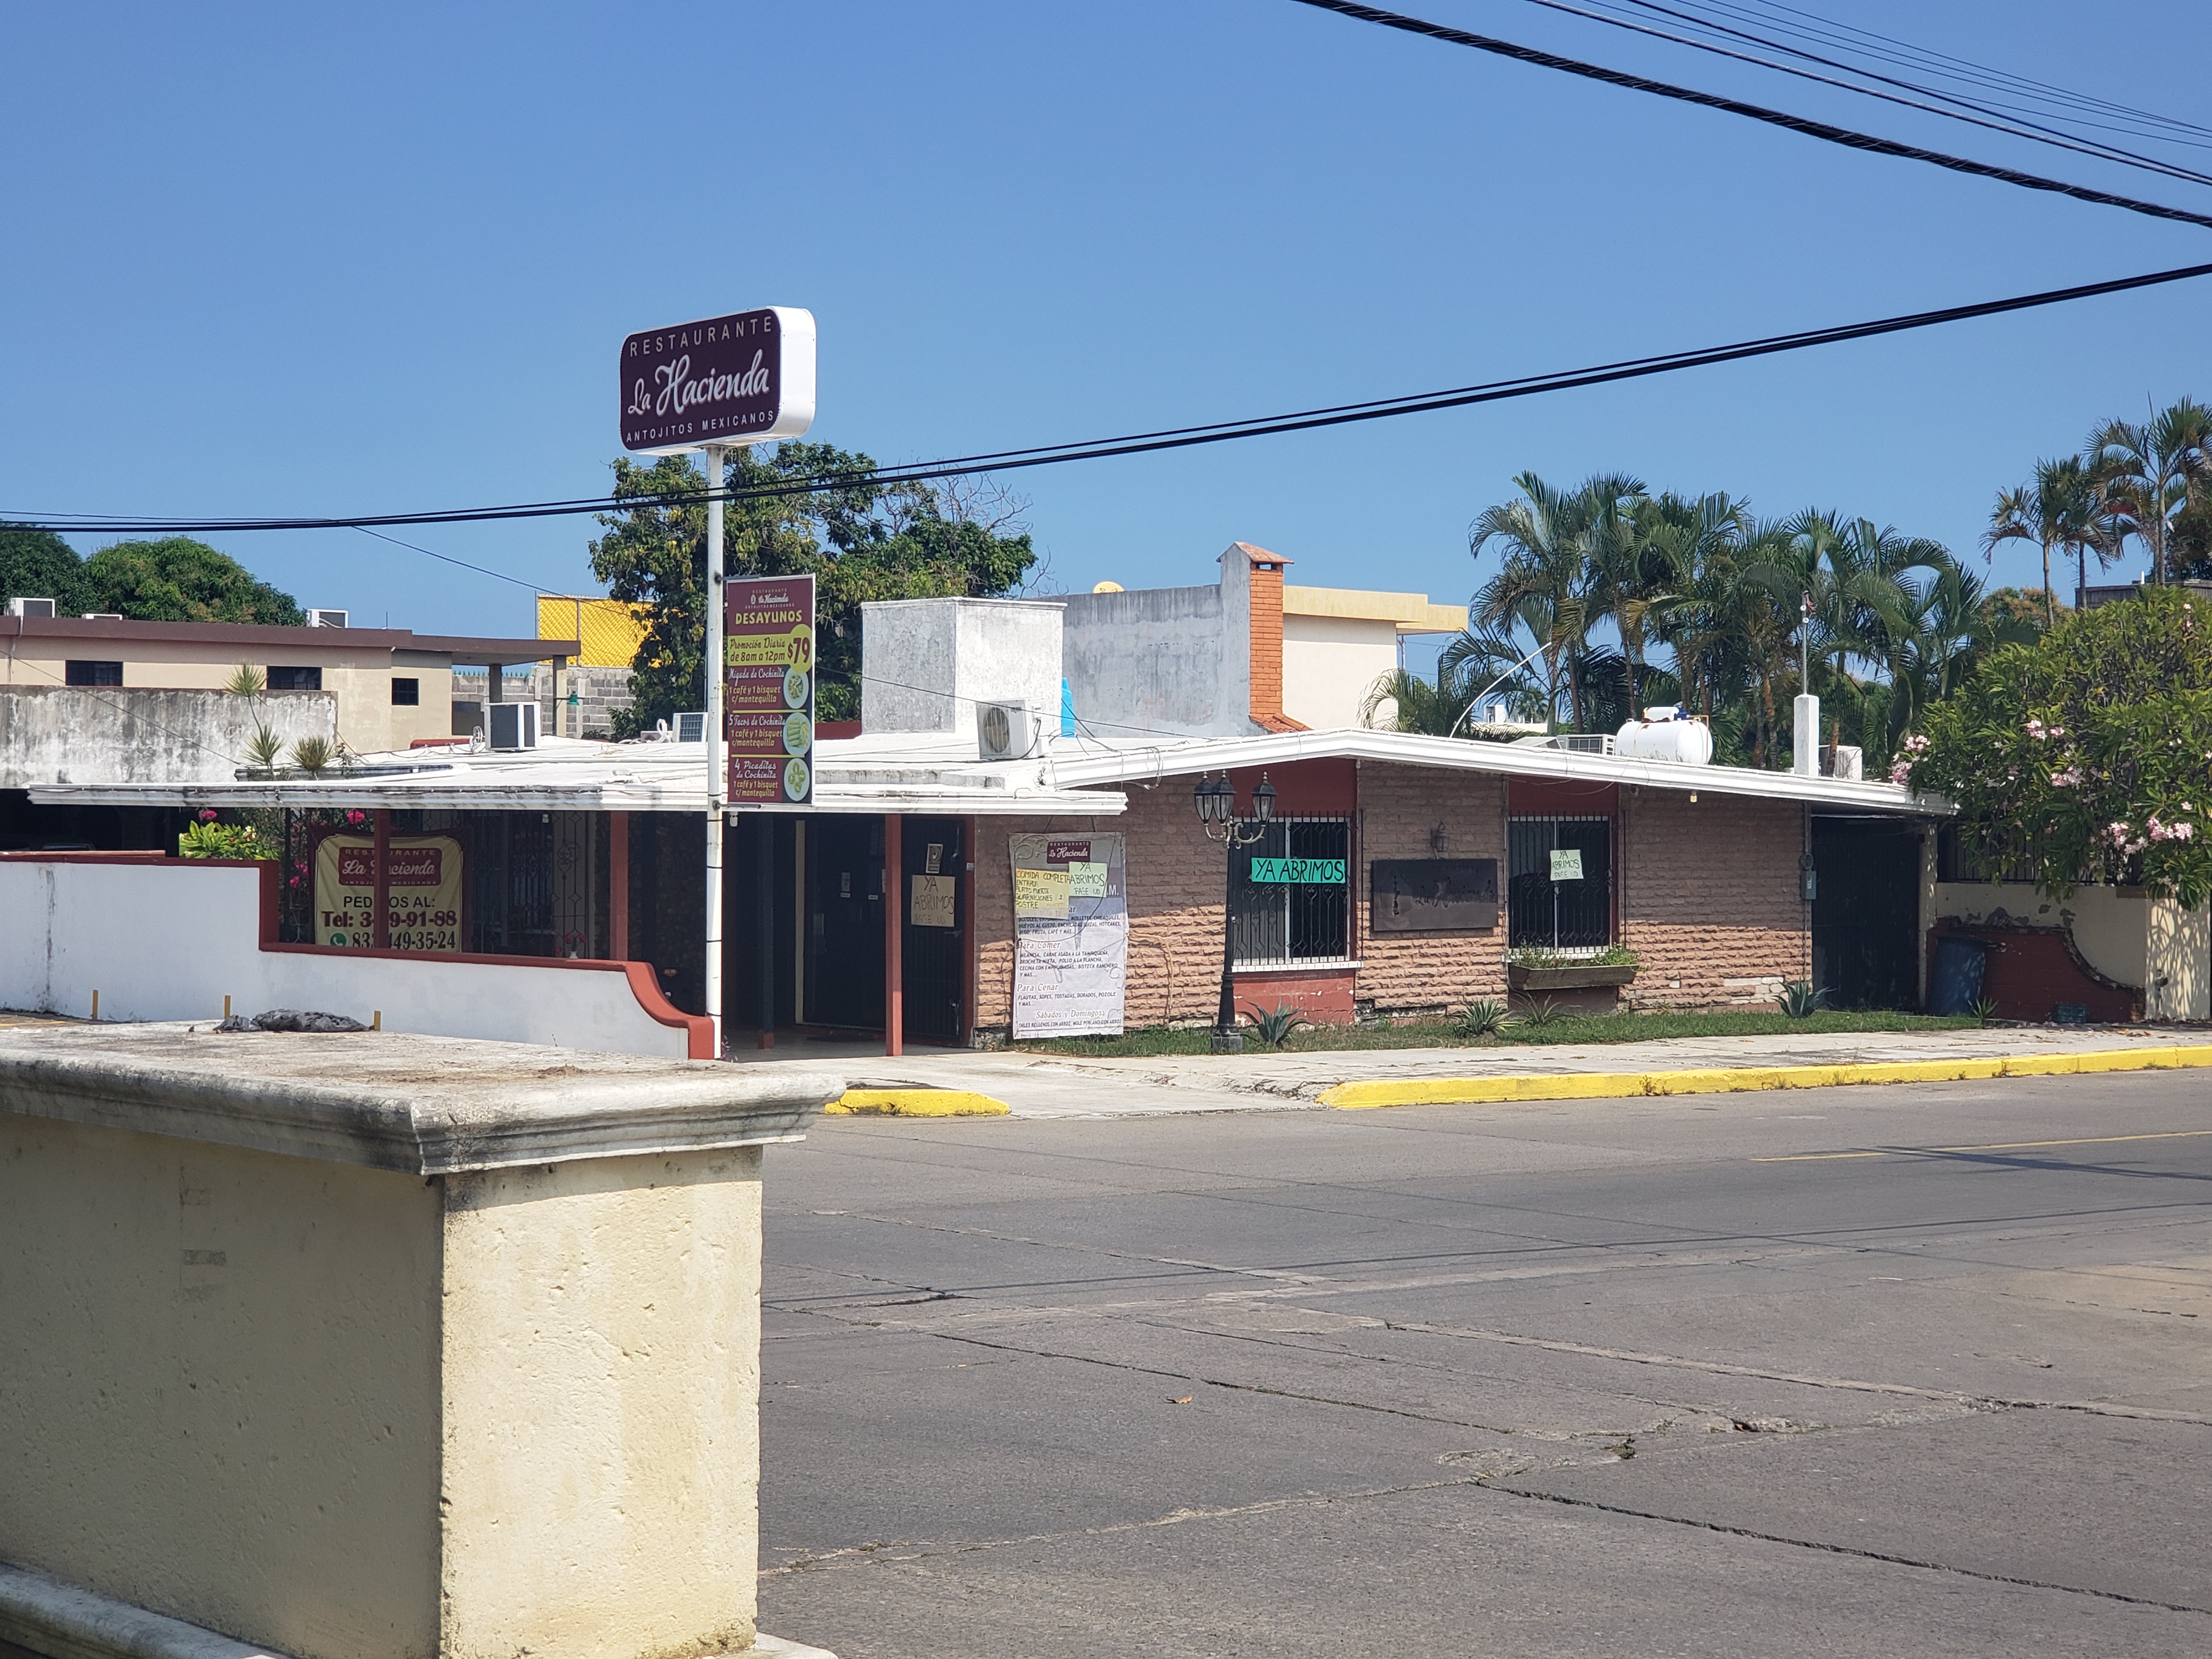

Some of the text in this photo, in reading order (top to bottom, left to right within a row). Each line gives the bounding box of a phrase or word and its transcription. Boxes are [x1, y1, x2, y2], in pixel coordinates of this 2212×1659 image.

[630, 315, 772, 357] RESTAURANTE
[628, 349, 769, 416] La Hacienda
[627, 410, 774, 442] ANTOJITOS MEXICANOS
[764, 593, 789, 604] Hacienda
[735, 610, 802, 624] DESAYUNOS
[730, 637, 785, 649] Promoción Diaria
[787, 637, 810, 664] $79
[730, 651, 739, 662] de
[741, 652, 757, 661] 8am
[765, 651, 785, 663] 12pm
[728, 667, 785, 687] Migada de Cochinita
[733, 686, 747, 695] café
[757, 685, 781, 695] bisquet
[729, 714, 786, 726] 5 Tacos de Cochinita
[735, 729, 748, 738] café
[759, 729, 782, 739] bisquet
[735, 758, 776, 770] 4 Picaditas
[744, 770, 776, 778] Cochinita
[737, 781, 748, 789] café
[757, 781, 778, 791] bisquet
[1057, 847, 1088, 858] Hacienda
[1559, 850, 1568, 859] YA
[342, 859, 367, 874] La
[1080, 862, 1092, 872] YA
[1551, 859, 1580, 870] ABRIMOS
[1017, 871, 1040, 879] COMIDA
[1256, 859, 1344, 883] YA ABRIMOS
[924, 876, 939, 893] YA
[1070, 873, 1105, 887] ABRIMOS
[344, 896, 435, 908] PEDOS AL:
[913, 894, 954, 915] ABRIMOS
[321, 910, 457, 928] Tel: 3-9-91-88
[915, 914, 932, 924] PASE
[1017, 984, 1034, 992] Para
[1036, 1011, 1062, 1019] Sábados
